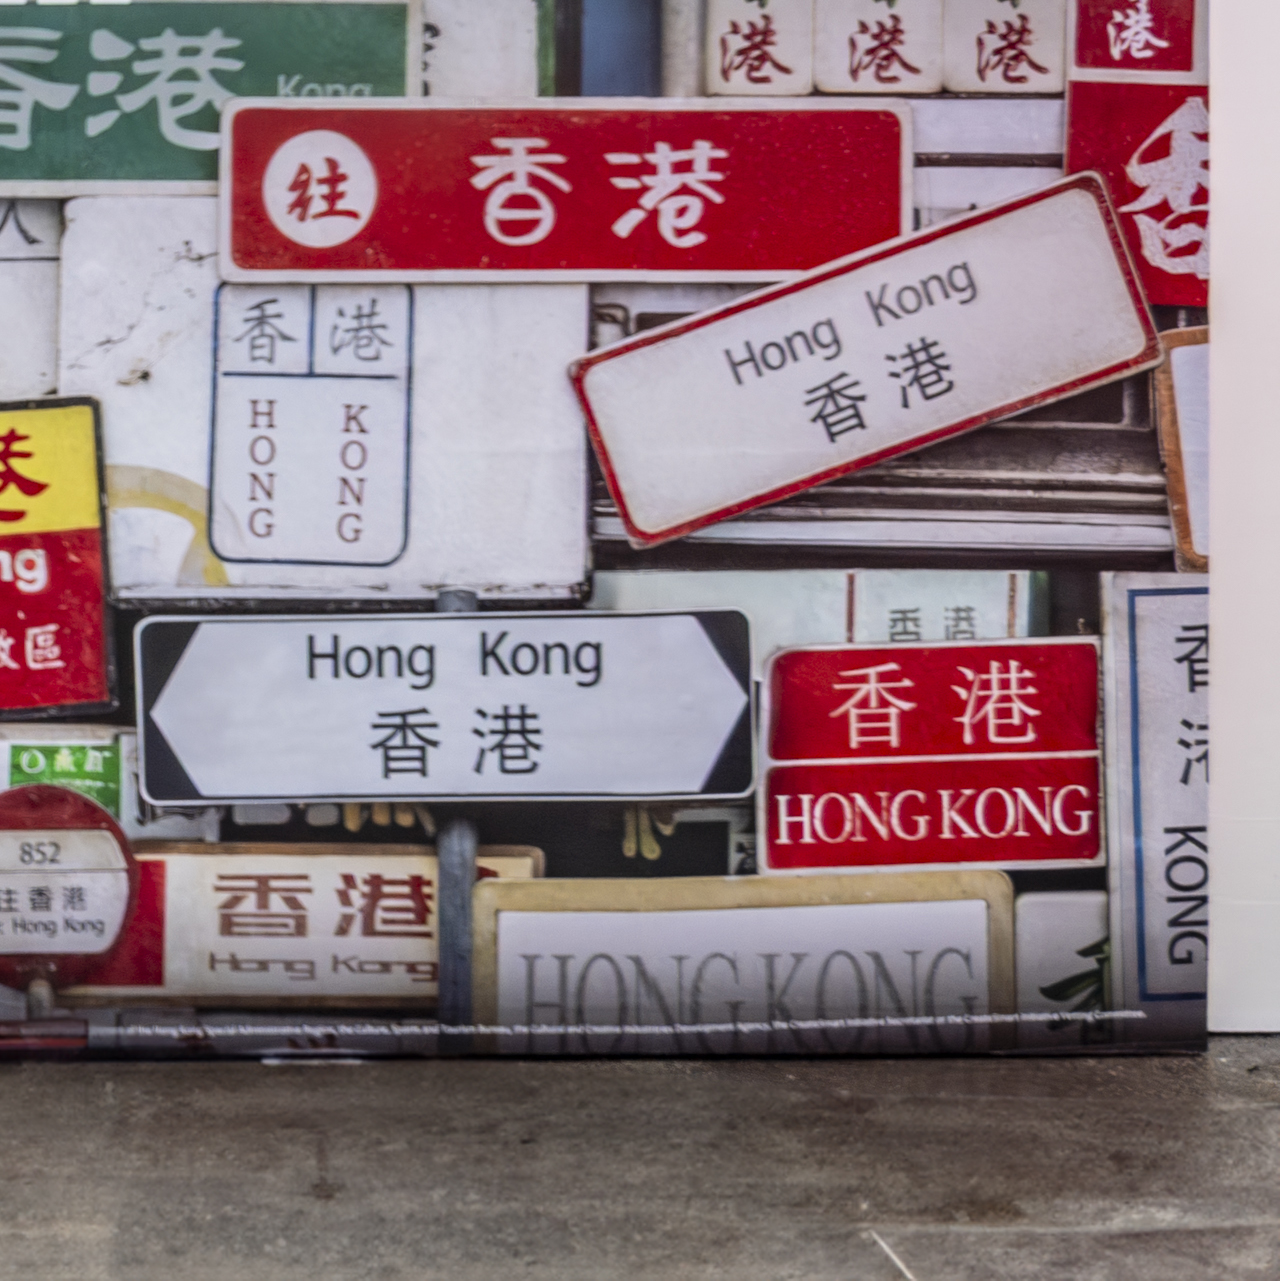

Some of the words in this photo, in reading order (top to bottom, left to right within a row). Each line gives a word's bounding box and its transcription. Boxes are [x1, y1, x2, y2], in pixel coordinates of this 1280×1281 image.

[468, 136, 730, 249] 香港
[233, 297, 396, 365] 香港
[722, 316, 843, 386] Hong
[864, 260, 980, 328] Kong
[803, 337, 957, 444] 香港
[247, 399, 278, 540] HONG
[335, 404, 370, 544] KONG
[305, 633, 436, 690] Hong
[479, 630, 604, 688] Kong
[369, 703, 545, 780] 香港
[828, 659, 1042, 751] 香港
[19, 842, 62, 864] 852
[774, 787, 930, 846] HONG
[940, 783, 1093, 840] KONG
[11, 917, 57, 937] Hong
[63, 917, 106, 938] Kong
[213, 872, 435, 941] 香港
[1162, 824, 1208, 966] KONG
[208, 950, 318, 982] Hong
[331, 954, 438, 983] Kong
[521, 951, 742, 1052] HONG
[756, 946, 981, 1051] KONG
